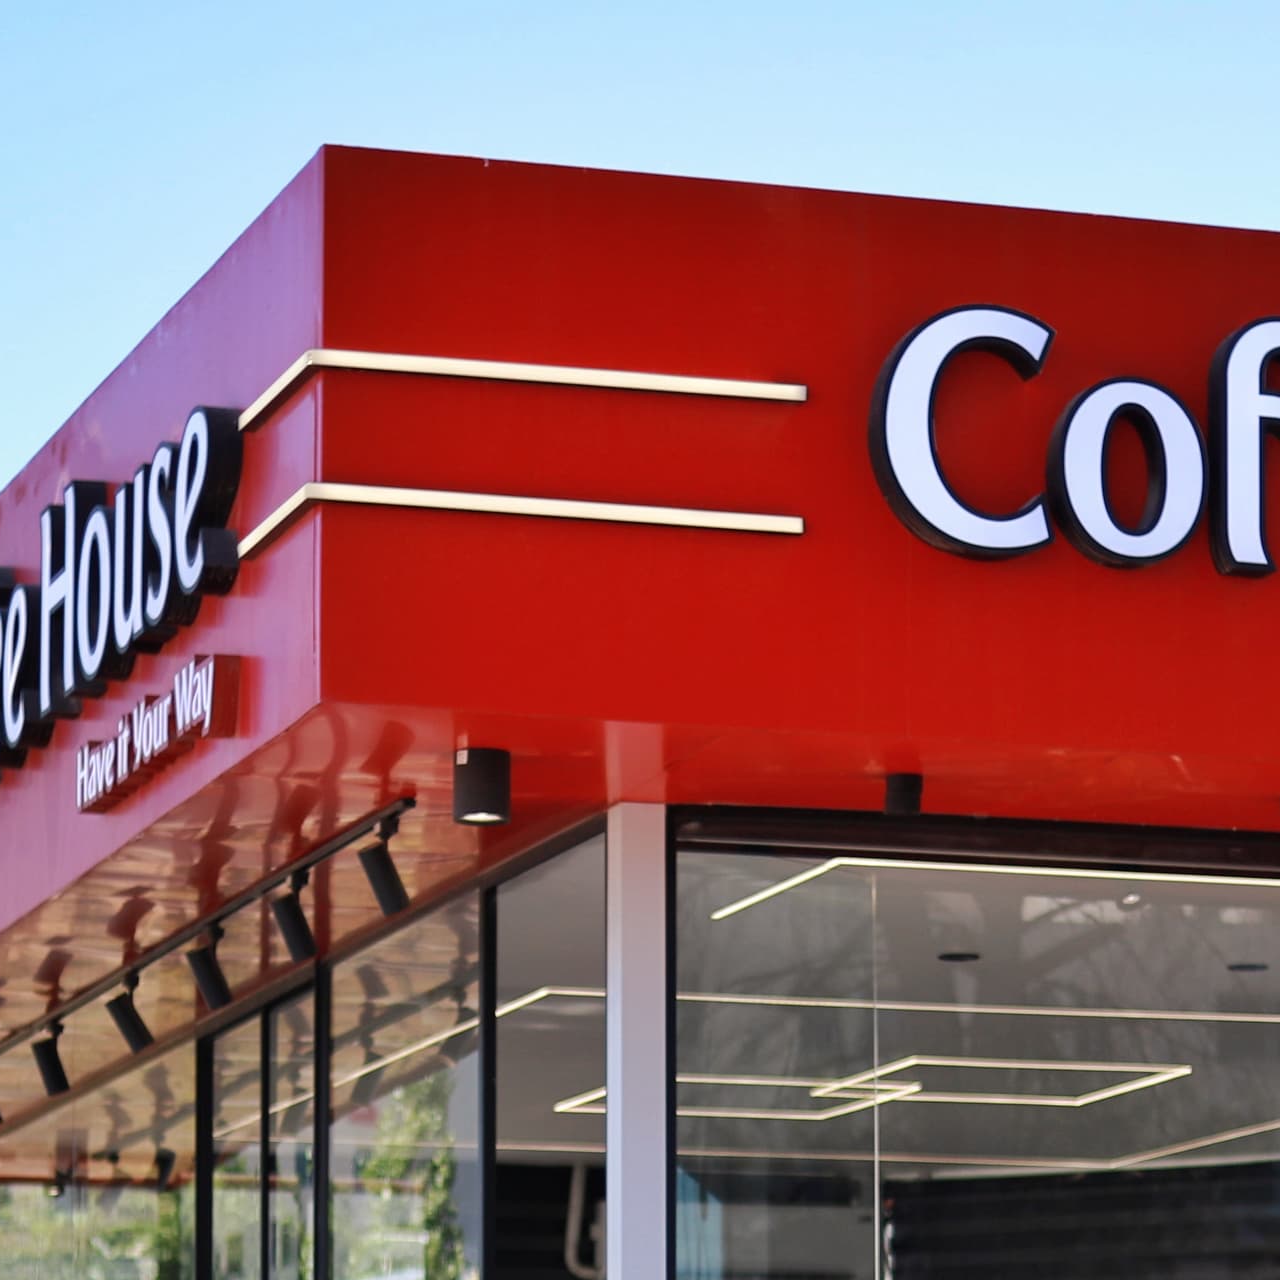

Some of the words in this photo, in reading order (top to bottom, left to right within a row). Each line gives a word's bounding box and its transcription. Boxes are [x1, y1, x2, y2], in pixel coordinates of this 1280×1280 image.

[40, 406, 210, 720] House
[77, 738, 116, 812] Have
[117, 720, 130, 784] it
[133, 694, 172, 772] Your
[174, 658, 215, 737] Way
